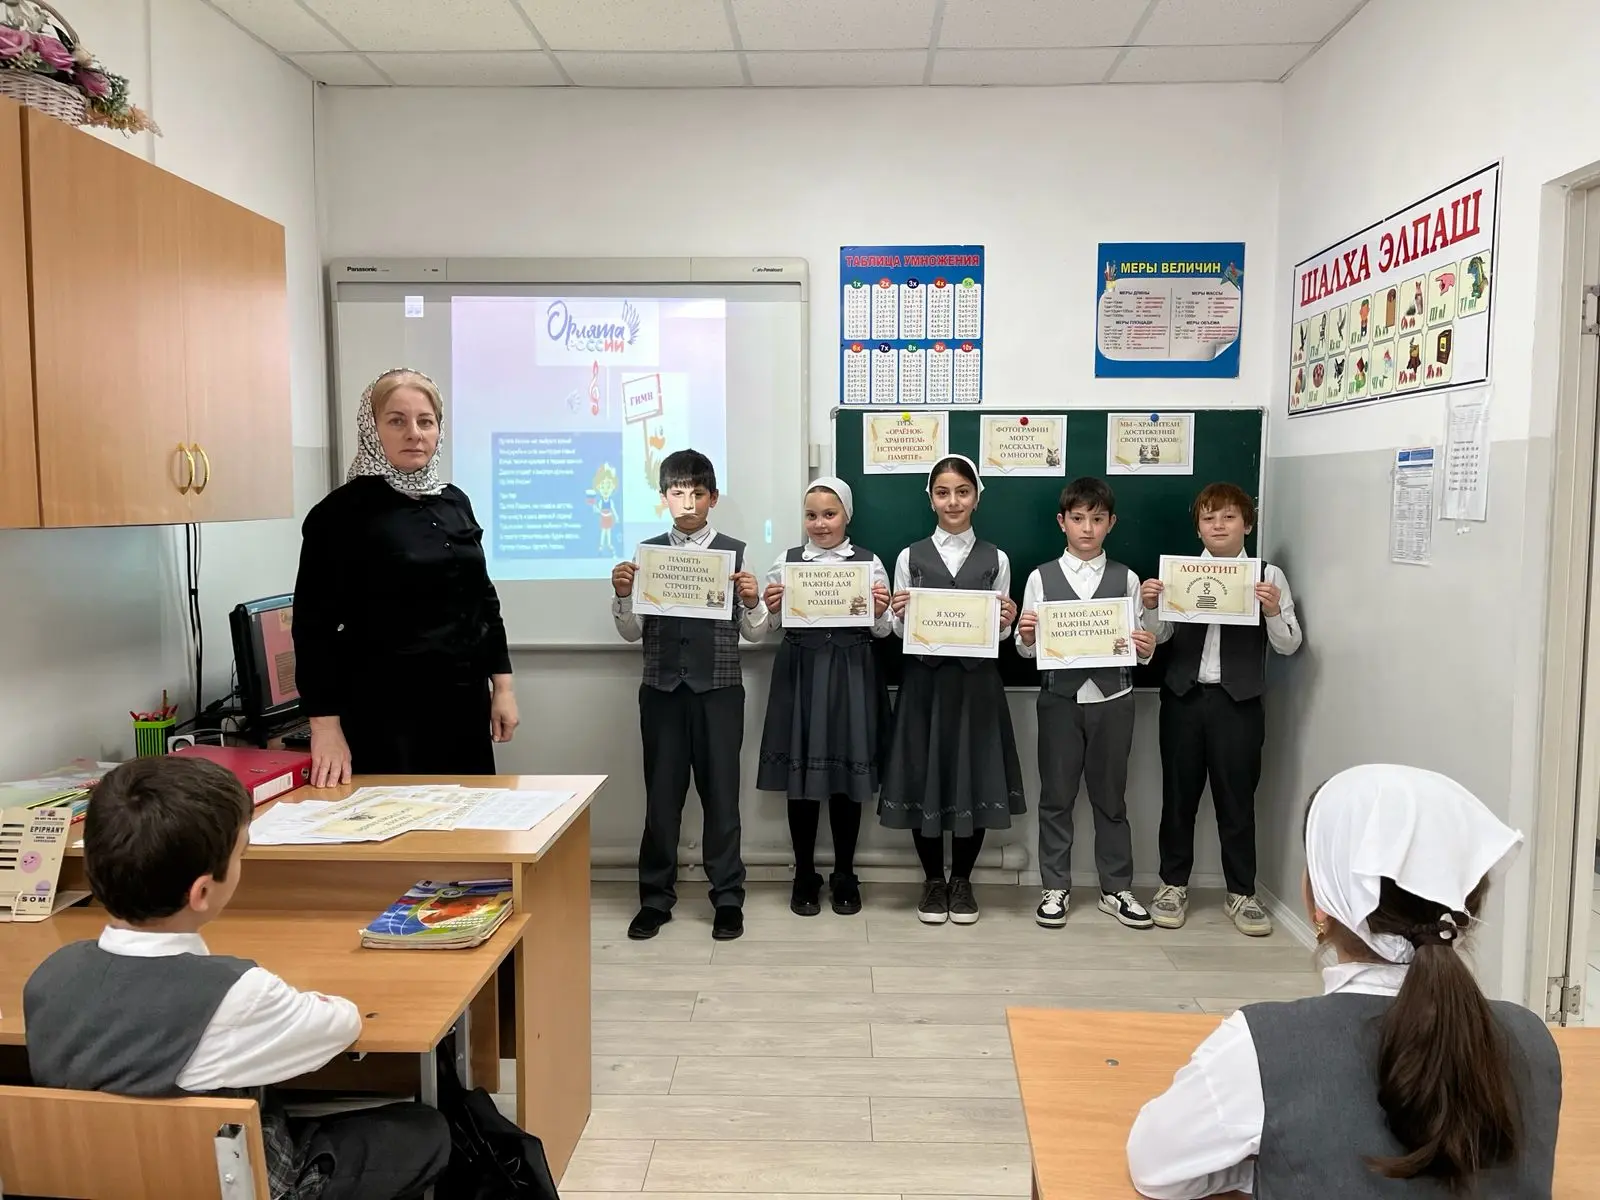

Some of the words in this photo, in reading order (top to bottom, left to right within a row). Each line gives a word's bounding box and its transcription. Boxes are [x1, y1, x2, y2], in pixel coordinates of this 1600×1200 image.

[1300, 244, 1370, 306] ШАЛХА
[1378, 189, 1482, 273] ЭЛПАШ
[846, 256, 901, 268] ТАБЛИЦА
[904, 254, 980, 266] УМНОЖЕНИЯ
[1120, 262, 1157, 274] МЕРЫ
[1161, 262, 1220, 274] ВЕЛИЧИН
[547, 300, 625, 350] Орлята
[630, 392, 654, 406] ГИМН
[668, 556, 701, 564] ПАМЯТЬ
[667, 565, 708, 574] ПРОШЛОМ
[1180, 565, 1238, 574] ЛОГОТИП
[652, 573, 696, 582] ПОМОГАЕТ
